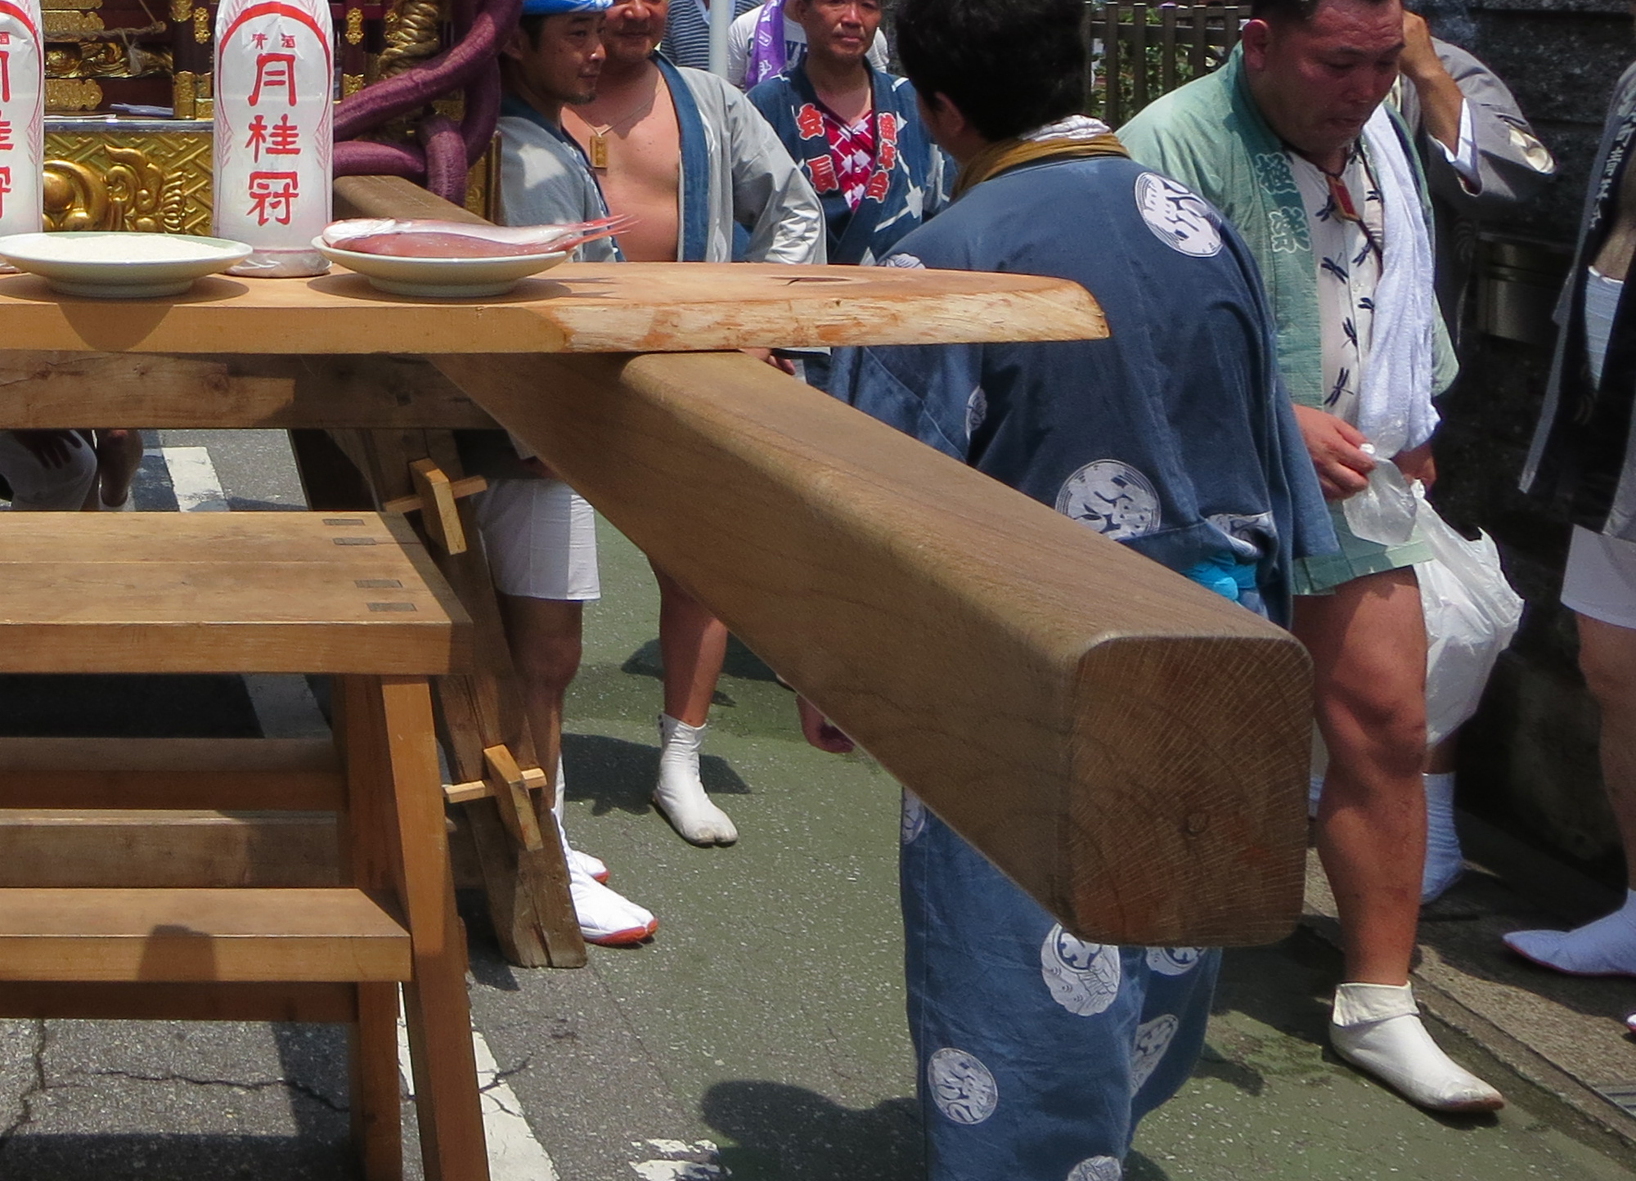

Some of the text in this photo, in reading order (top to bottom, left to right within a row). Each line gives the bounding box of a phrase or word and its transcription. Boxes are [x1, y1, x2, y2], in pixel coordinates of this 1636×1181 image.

[245, 53, 301, 226] 月桂冠
[796, 103, 839, 194] 会長
